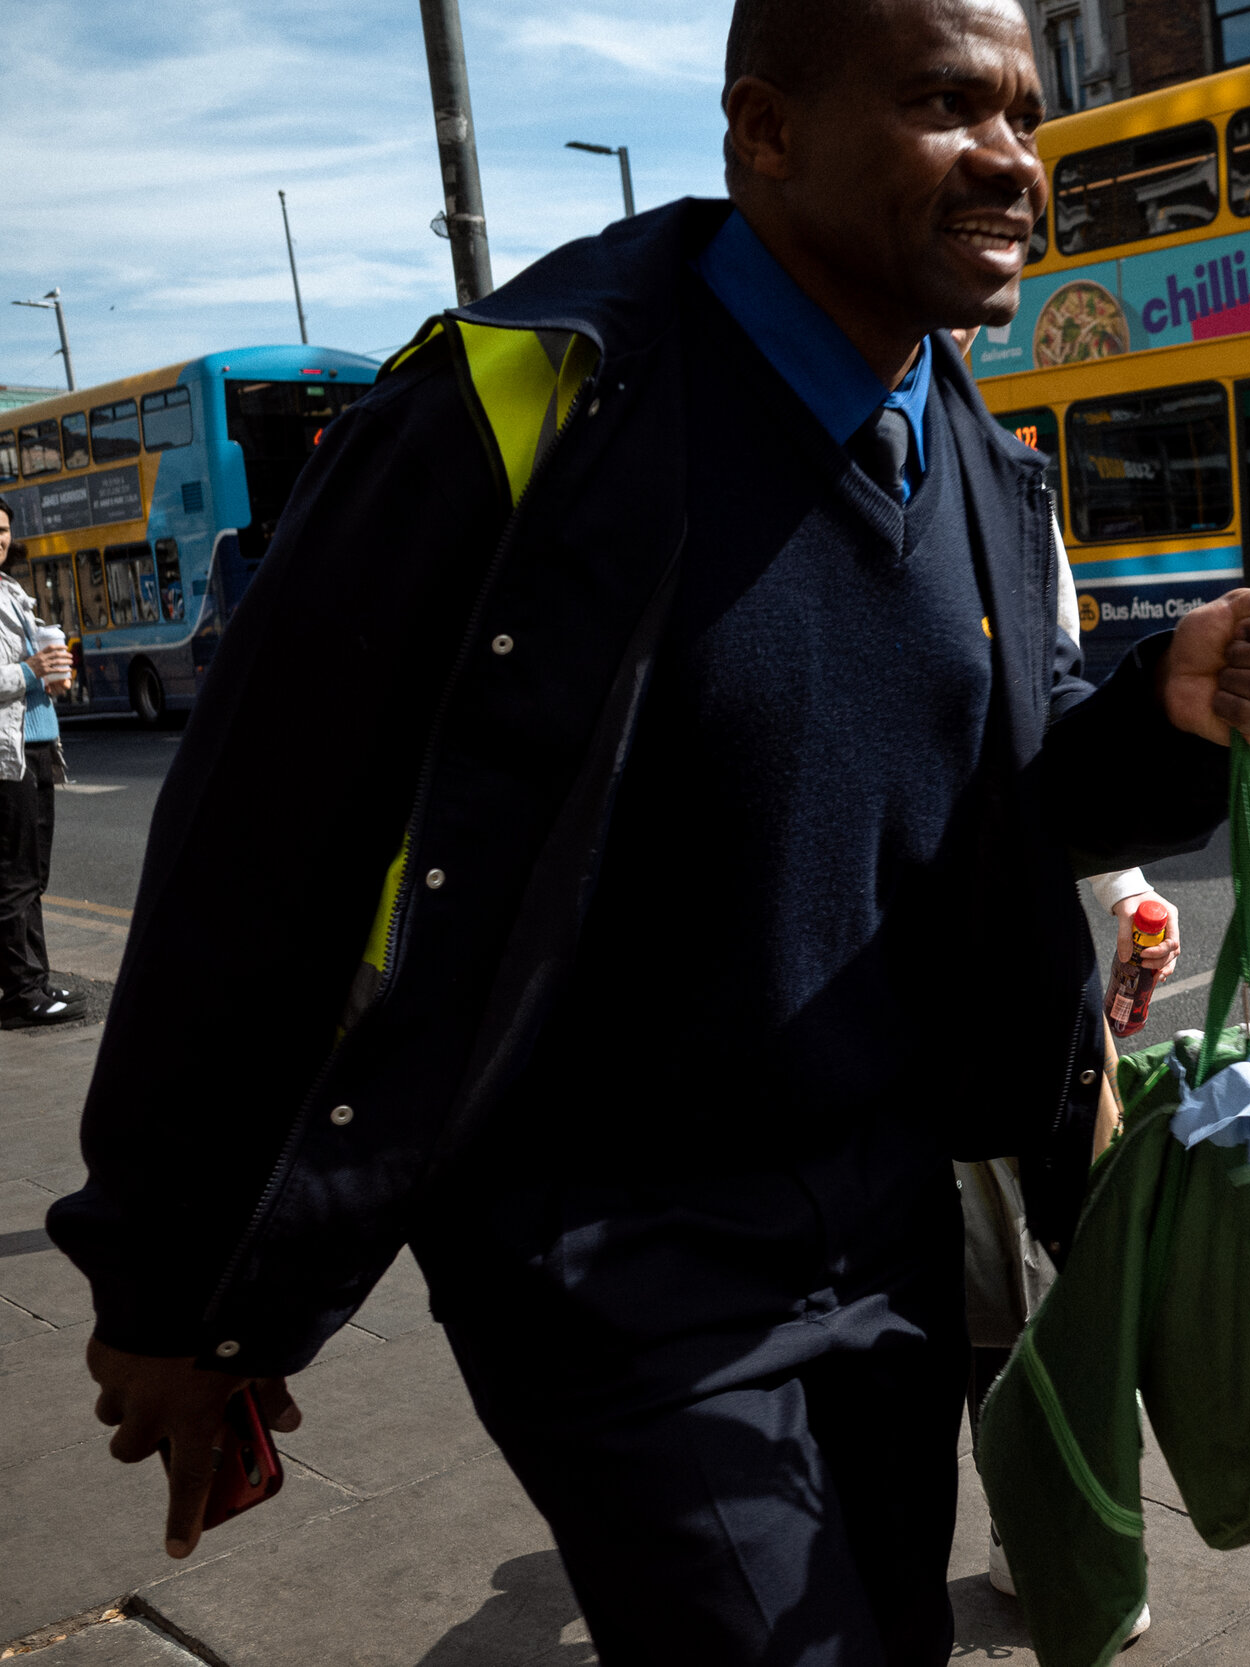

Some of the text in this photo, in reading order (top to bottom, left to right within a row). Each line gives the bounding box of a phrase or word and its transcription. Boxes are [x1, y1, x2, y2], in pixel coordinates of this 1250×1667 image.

[1142, 250, 1250, 334] chilli
[1101, 602, 1129, 621] Bus
[1130, 596, 1164, 619] Átha
